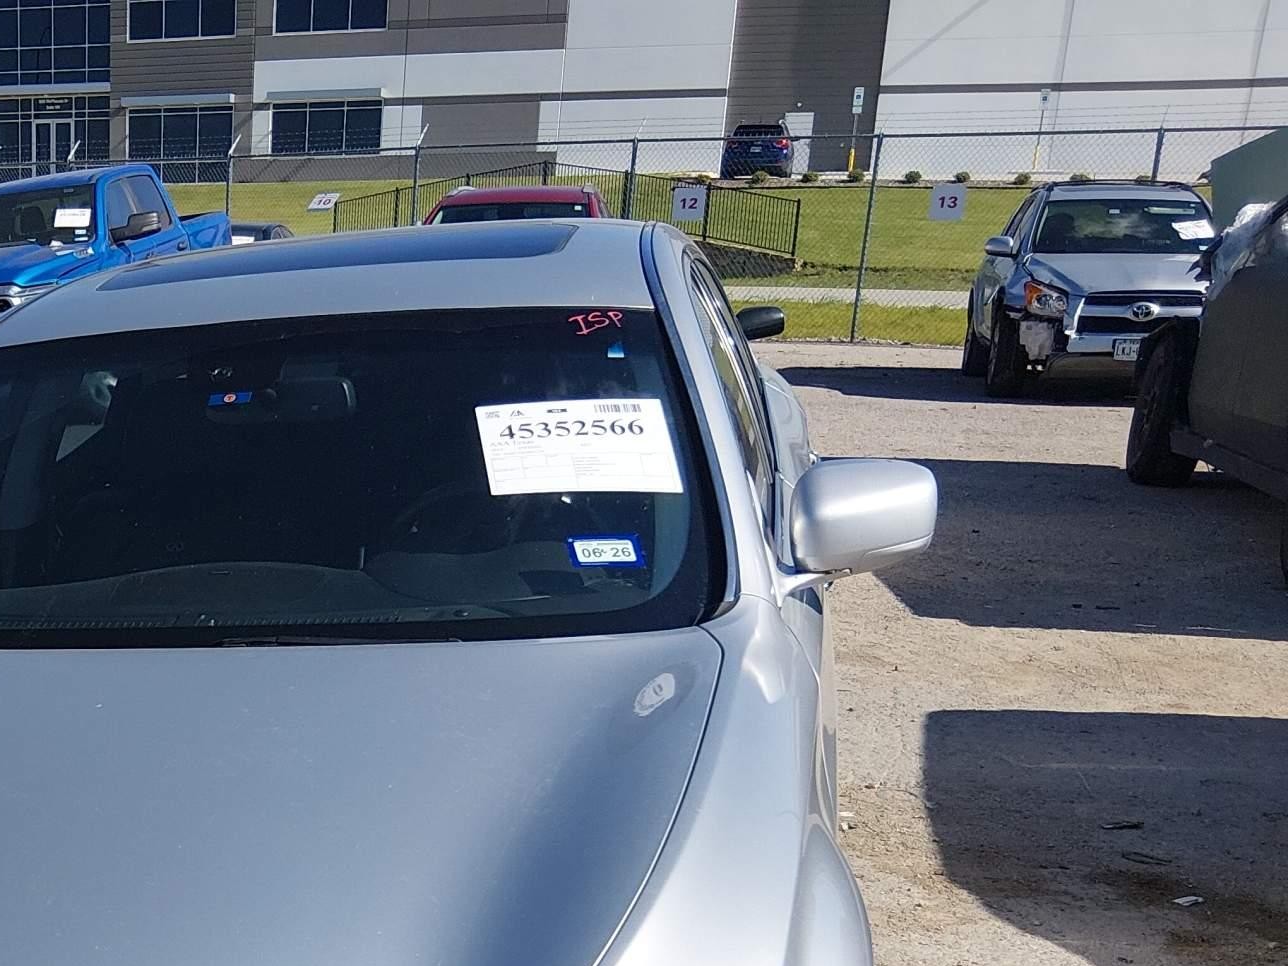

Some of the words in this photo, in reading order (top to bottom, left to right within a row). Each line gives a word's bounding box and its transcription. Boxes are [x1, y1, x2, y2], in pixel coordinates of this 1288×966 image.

[316, 198, 332, 206] 10
[679, 197, 698, 210] 12
[938, 195, 958, 209] 13
[568, 311, 623, 335] ISP
[499, 418, 645, 440] 45352566
[581, 547, 602, 559] 06
[610, 546, 632, 558] 26
